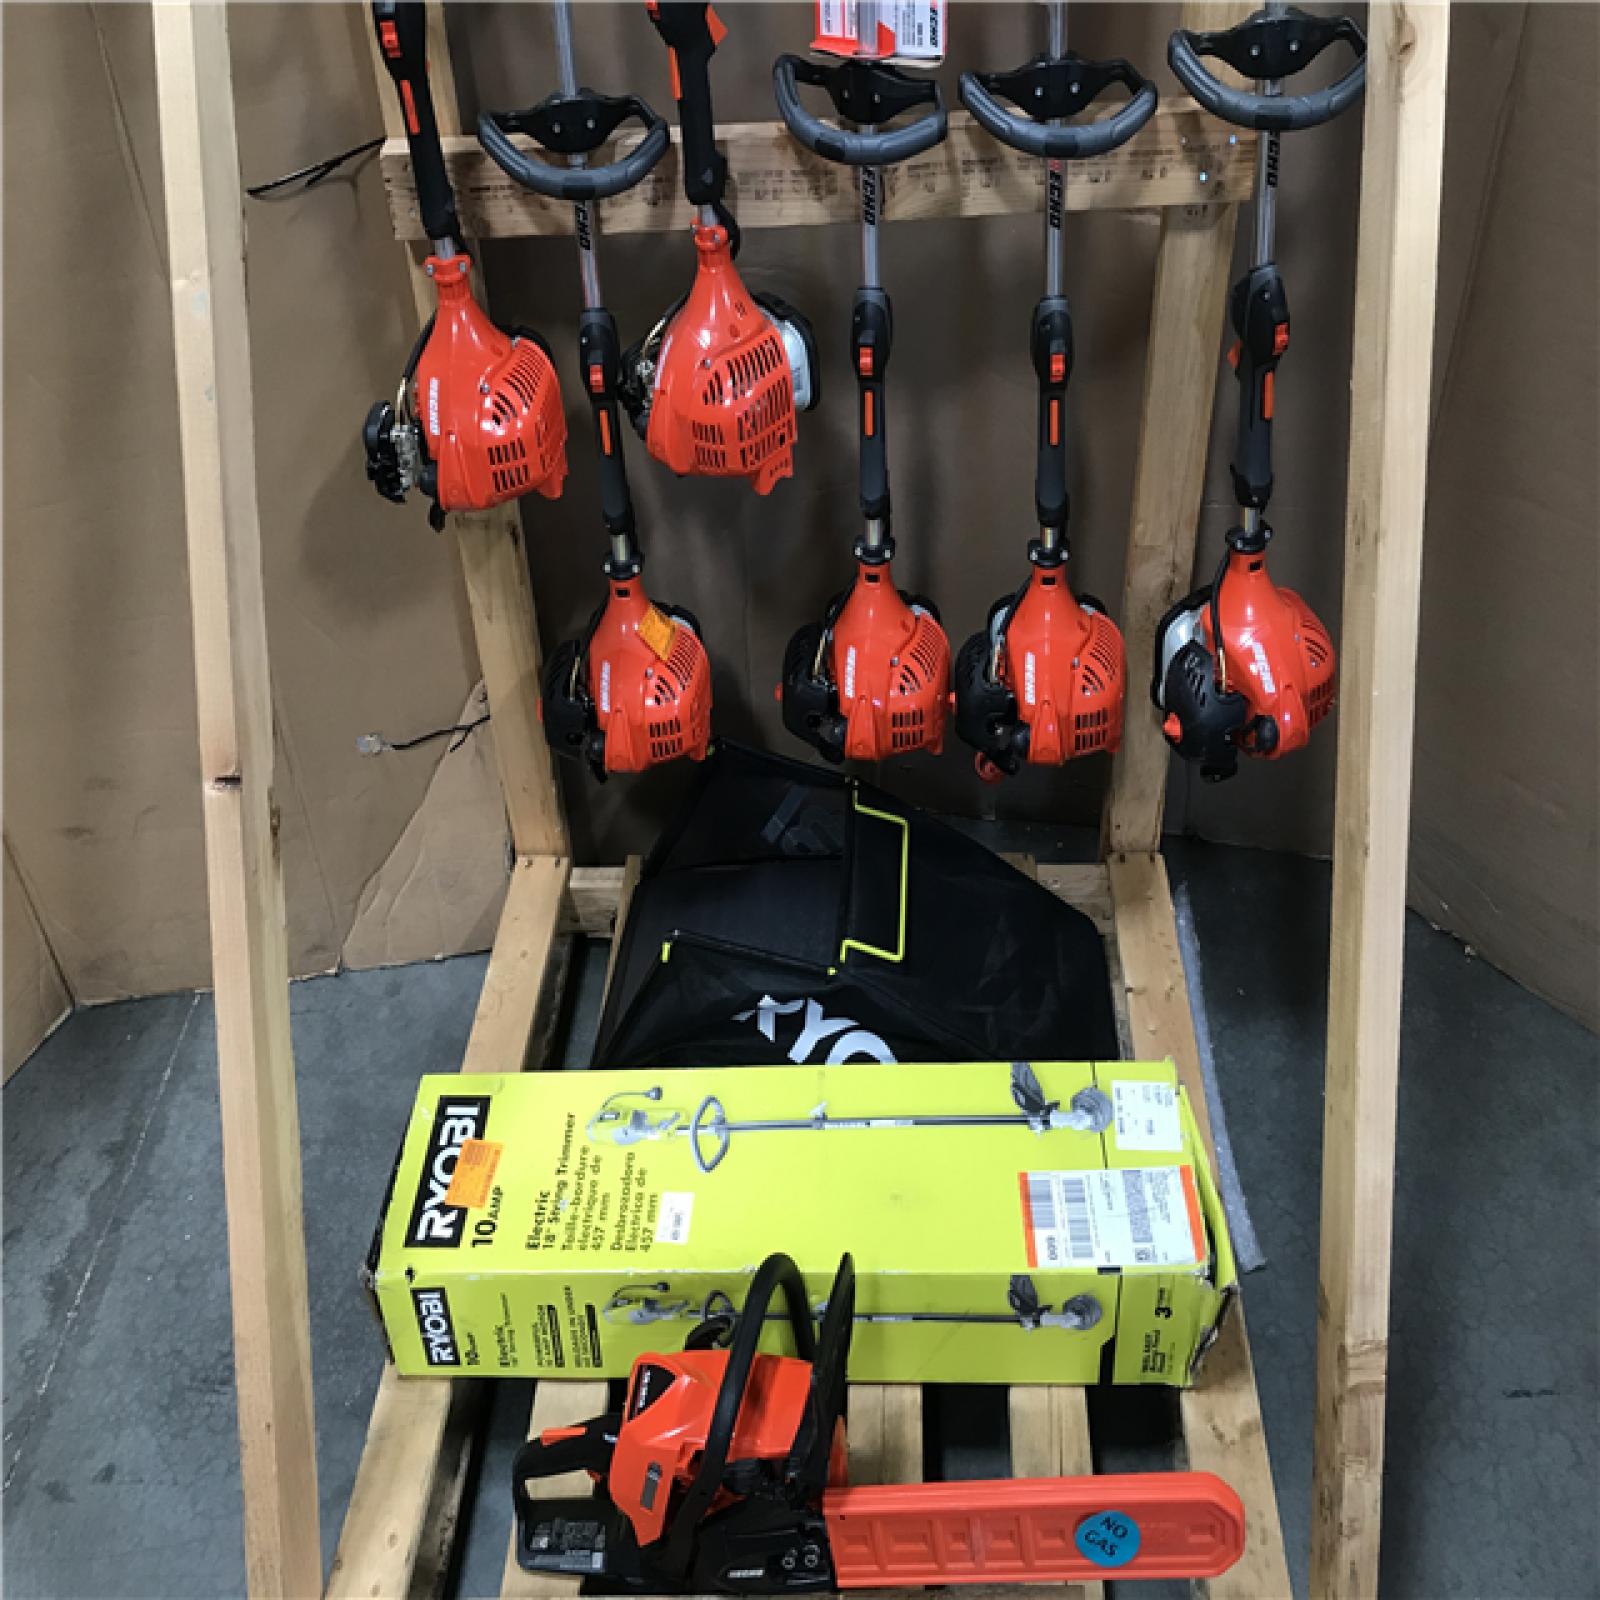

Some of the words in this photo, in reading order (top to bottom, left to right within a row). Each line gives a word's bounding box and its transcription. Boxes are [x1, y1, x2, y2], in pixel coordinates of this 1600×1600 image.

[862, 165, 876, 226] ECHO
[1049, 170, 1064, 229] ECHO
[416, 1105, 479, 1241] RYOBI
[554, 1112, 576, 1176] Trimmer
[589, 1155, 602, 1176] de
[525, 1190, 551, 1251] Electric
[546, 1180, 568, 1225] String
[599, 1192, 611, 1221] mm
[416, 1291, 456, 1364] RYOBI
[1084, 1530, 1119, 1558] GAS
[1100, 1516, 1129, 1539] NO
